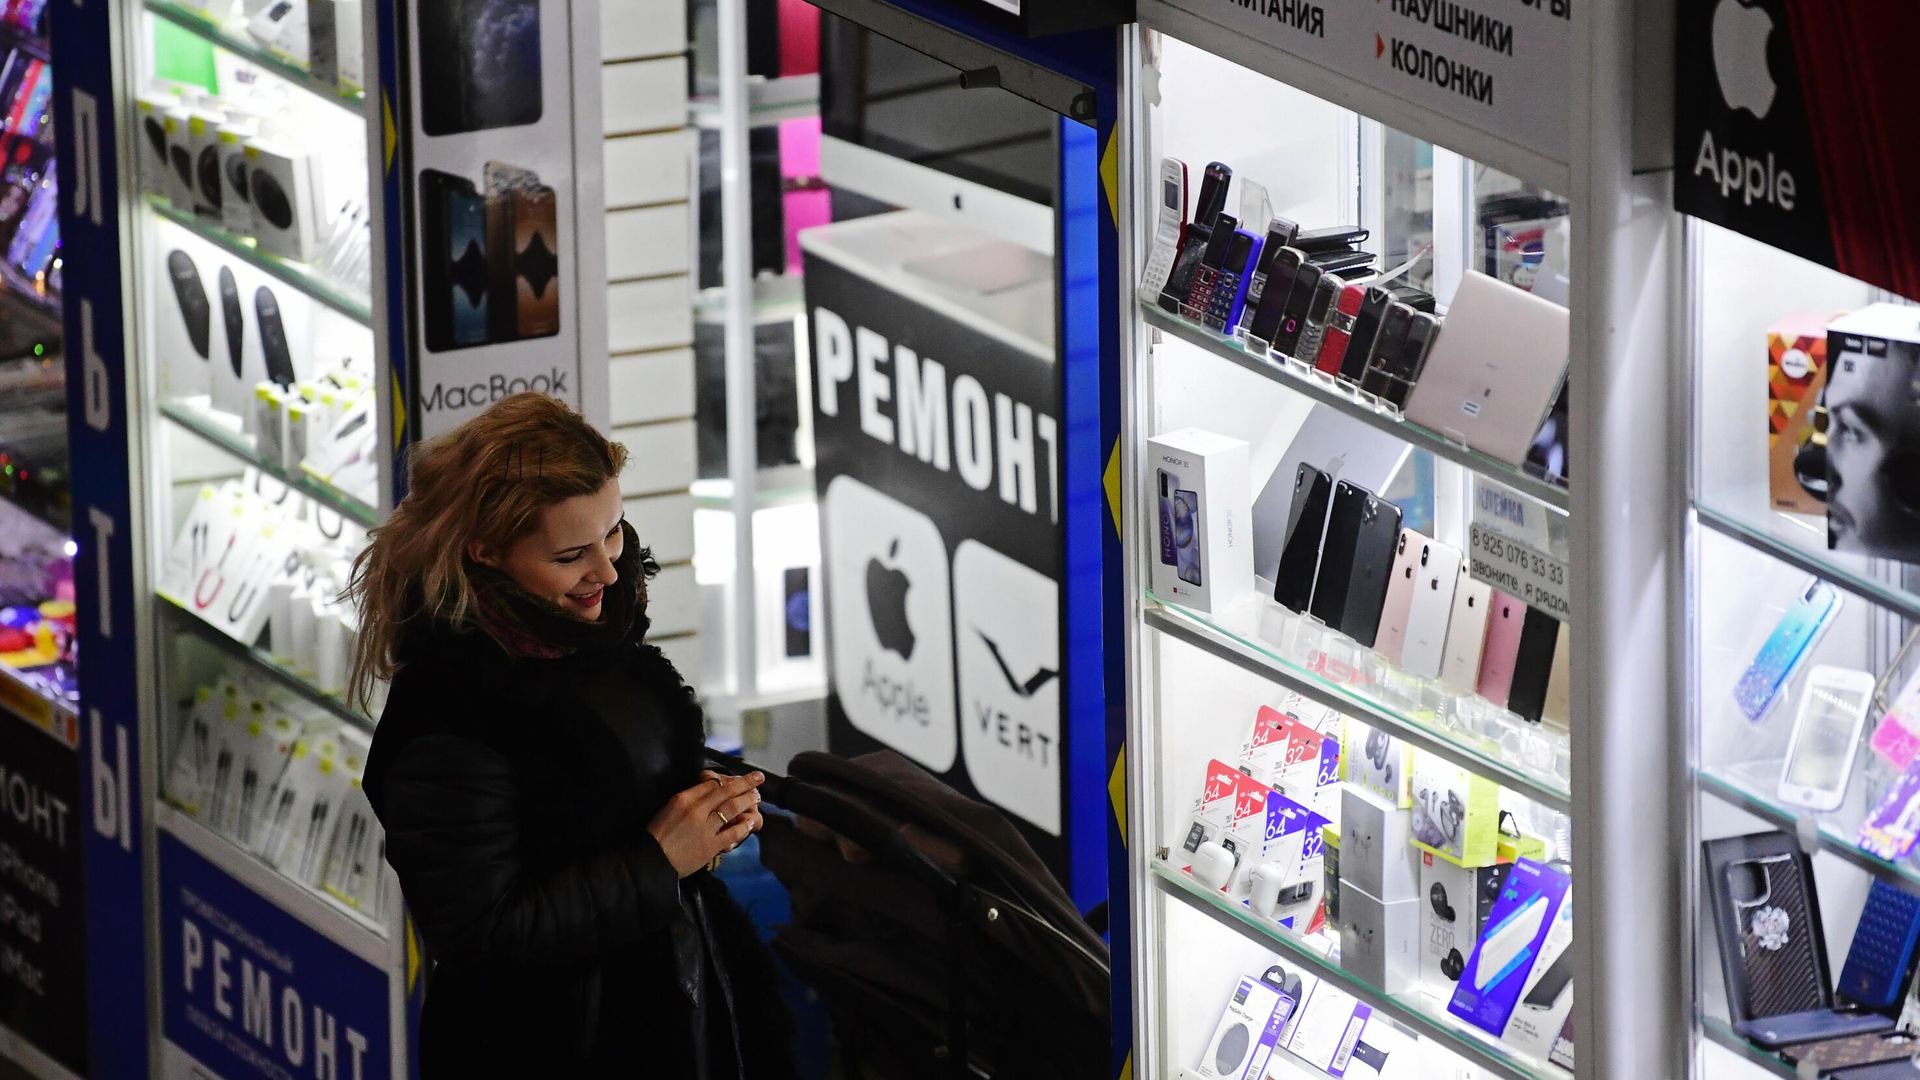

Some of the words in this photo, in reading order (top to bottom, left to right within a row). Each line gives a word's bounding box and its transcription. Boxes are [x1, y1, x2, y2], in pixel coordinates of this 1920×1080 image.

[1229, 0, 1325, 38] АНИЯ
[1391, 37, 1494, 106] КОЛОНКИ
[1694, 128, 1796, 211] Apple
[420, 366, 569, 413] MacBook
[72, 0, 133, 853] ЛЬТЫ
[813, 305, 1059, 526] РЕМОНТ
[1162, 455, 1183, 466] HONOR
[1472, 528, 1480, 546] 8
[1482, 532, 1504, 558] 925
[1506, 544, 1529, 569] 076
[1531, 555, 1546, 577] 33
[1549, 563, 1564, 585] 33
[1525, 583, 1533, 597] я
[861, 658, 930, 728] Apple
[974, 699, 1058, 769] VERT
[1251, 728, 1270, 747] 64
[1285, 745, 1305, 765] 32
[1318, 763, 1339, 786] 64
[1203, 781, 1220, 802] 64
[1235, 798, 1251, 818] 64
[1265, 815, 1286, 839] 64
[1303, 836, 1323, 860] 32
[1430, 922, 1455, 949] ZERO
[182, 917, 369, 1080] РЕМОНТ
